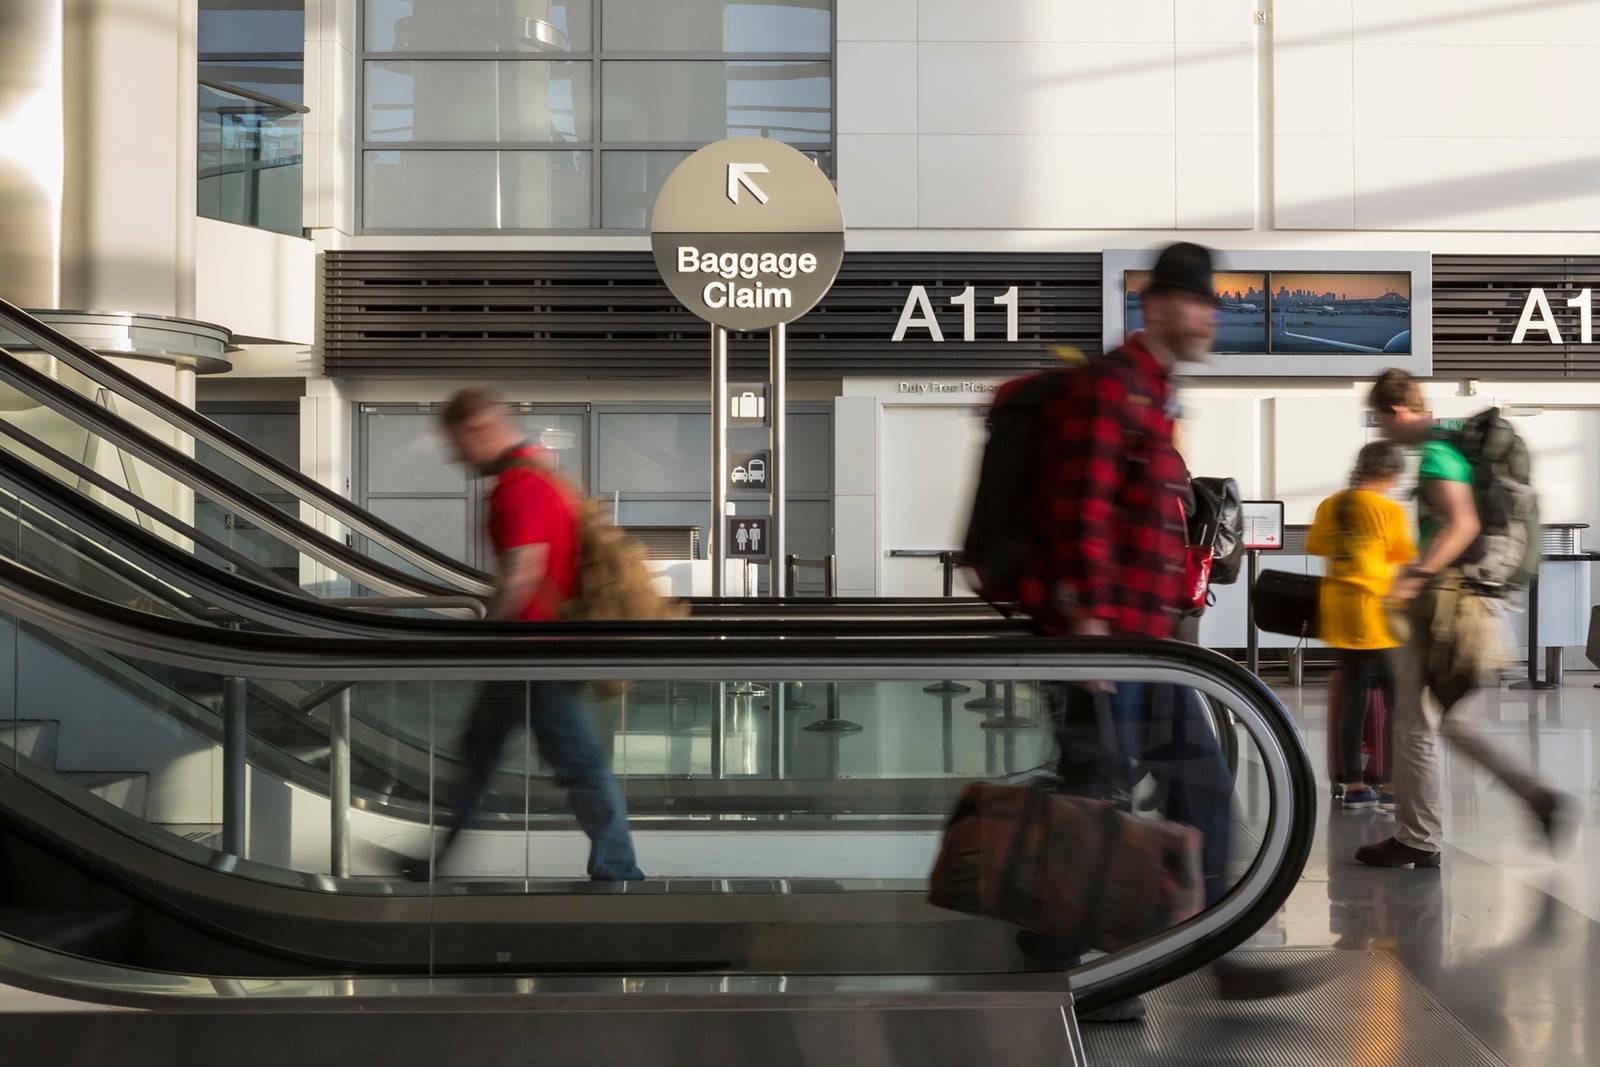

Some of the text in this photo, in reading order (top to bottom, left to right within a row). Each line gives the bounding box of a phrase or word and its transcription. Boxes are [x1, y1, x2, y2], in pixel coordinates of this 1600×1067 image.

[677, 246, 817, 279] Baggage
[703, 281, 792, 309] Claim
[891, 285, 1018, 342] A11
[899, 381, 928, 394] Duty
[932, 381, 958, 393] Free
